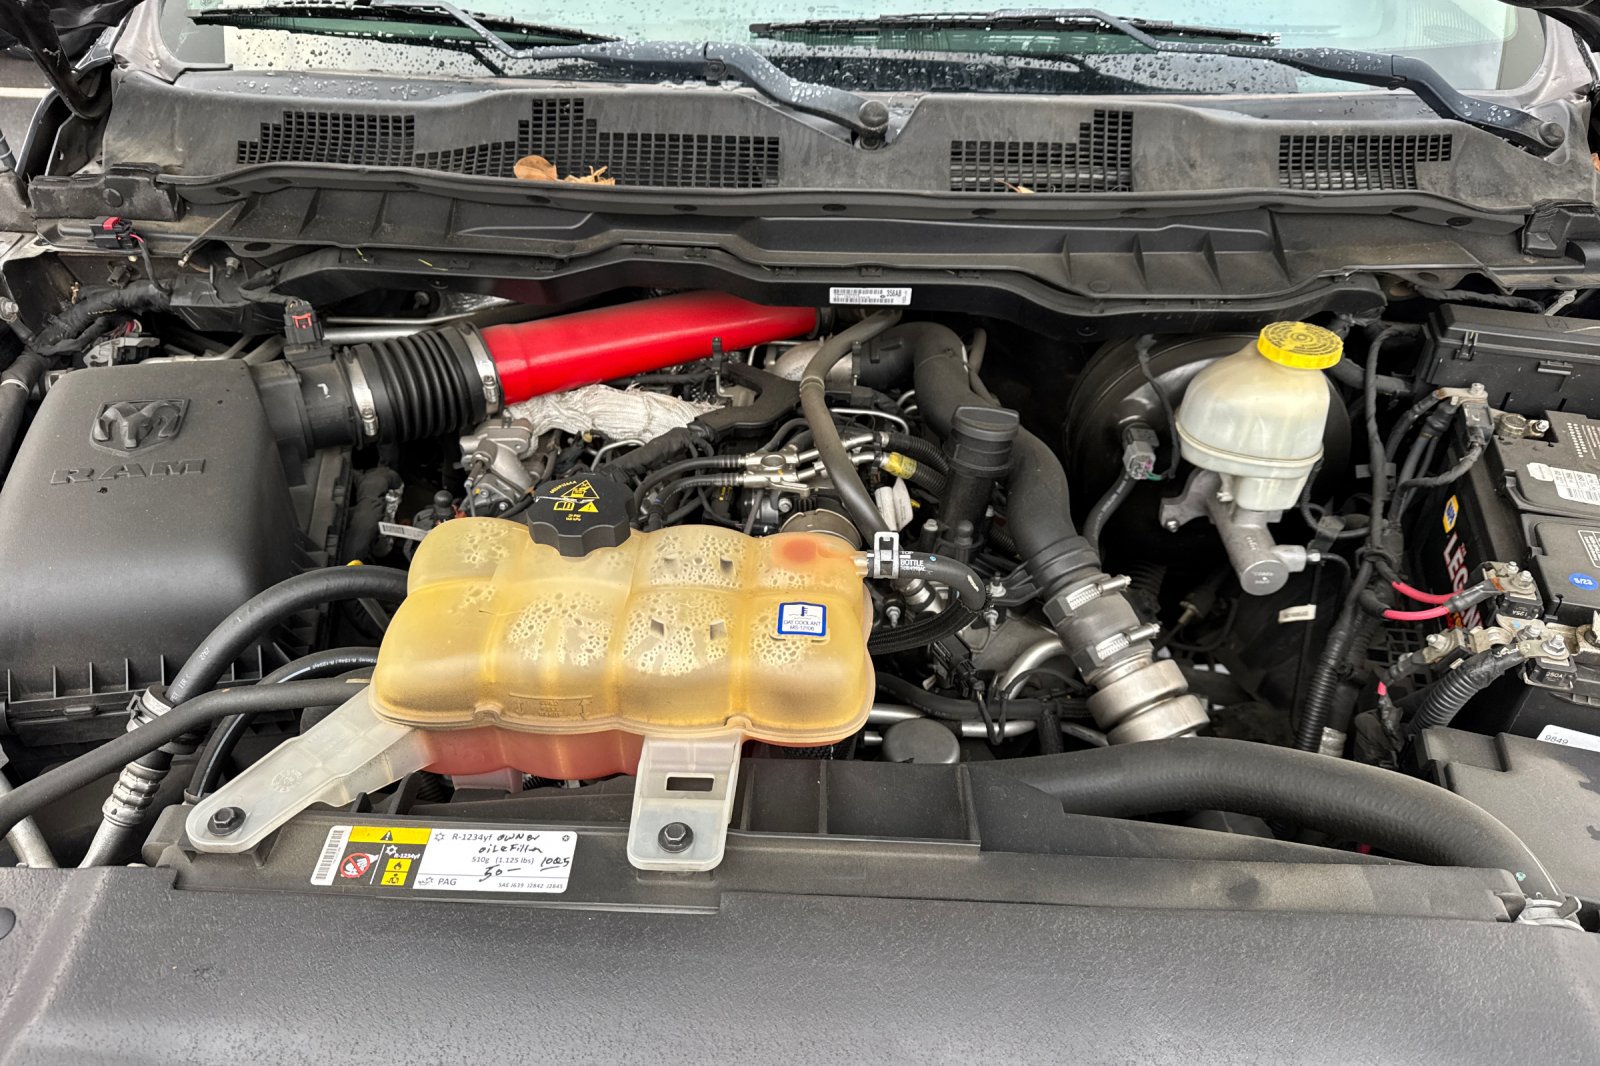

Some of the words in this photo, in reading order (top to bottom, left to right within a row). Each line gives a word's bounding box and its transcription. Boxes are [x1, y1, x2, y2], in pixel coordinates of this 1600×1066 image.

[50, 458, 207, 485] RAM
[900, 559, 924, 567] BOTTLE
[1545, 671, 1563, 679] 250A
[1544, 734, 1569, 745] 9849
[451, 833, 493, 843] R-1234yf
[471, 856, 490, 864] 510g
[520, 857, 535, 865] lbs)
[437, 878, 457, 886] PAG
